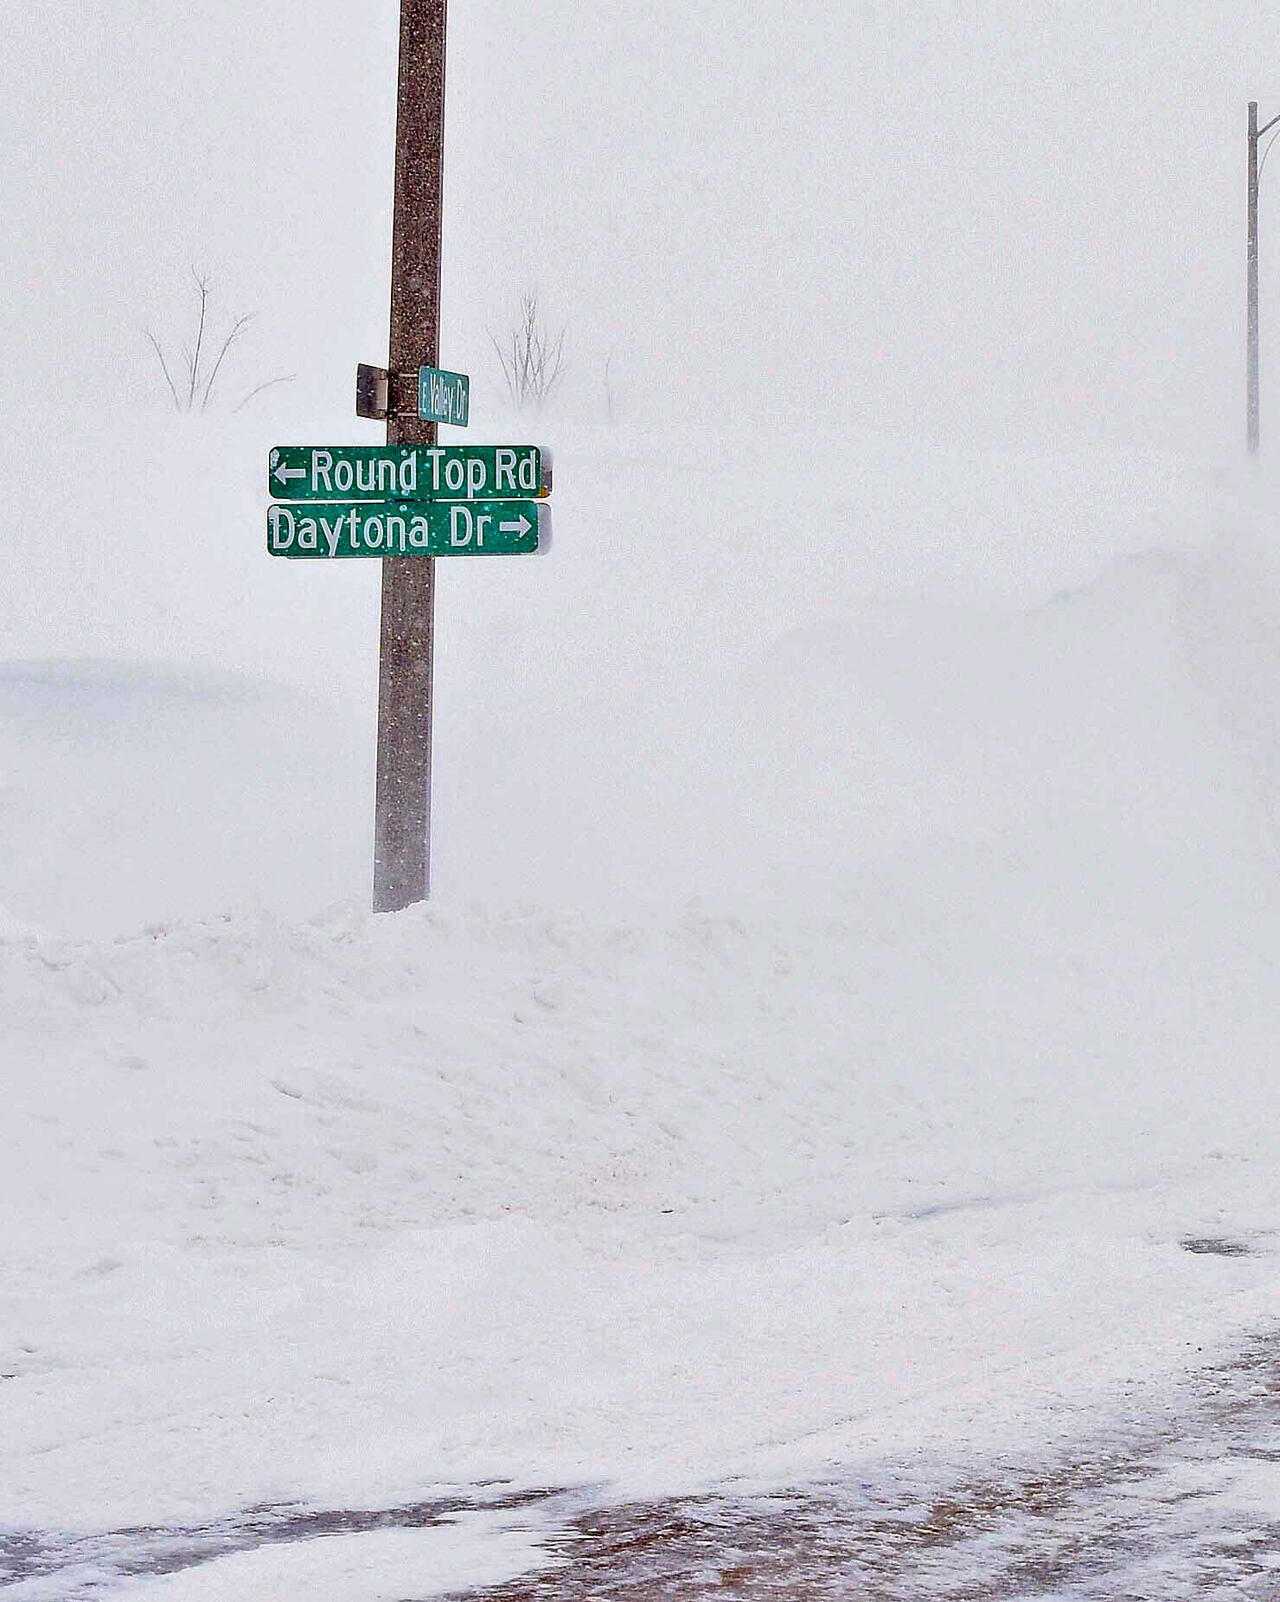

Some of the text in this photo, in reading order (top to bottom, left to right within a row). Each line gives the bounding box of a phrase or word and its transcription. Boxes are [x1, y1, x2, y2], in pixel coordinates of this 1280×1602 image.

[429, 373, 456, 424] Valley
[456, 379, 467, 420] Dr
[311, 448, 537, 499] Round Top Rd
[271, 505, 492, 557] Daytona Dr
